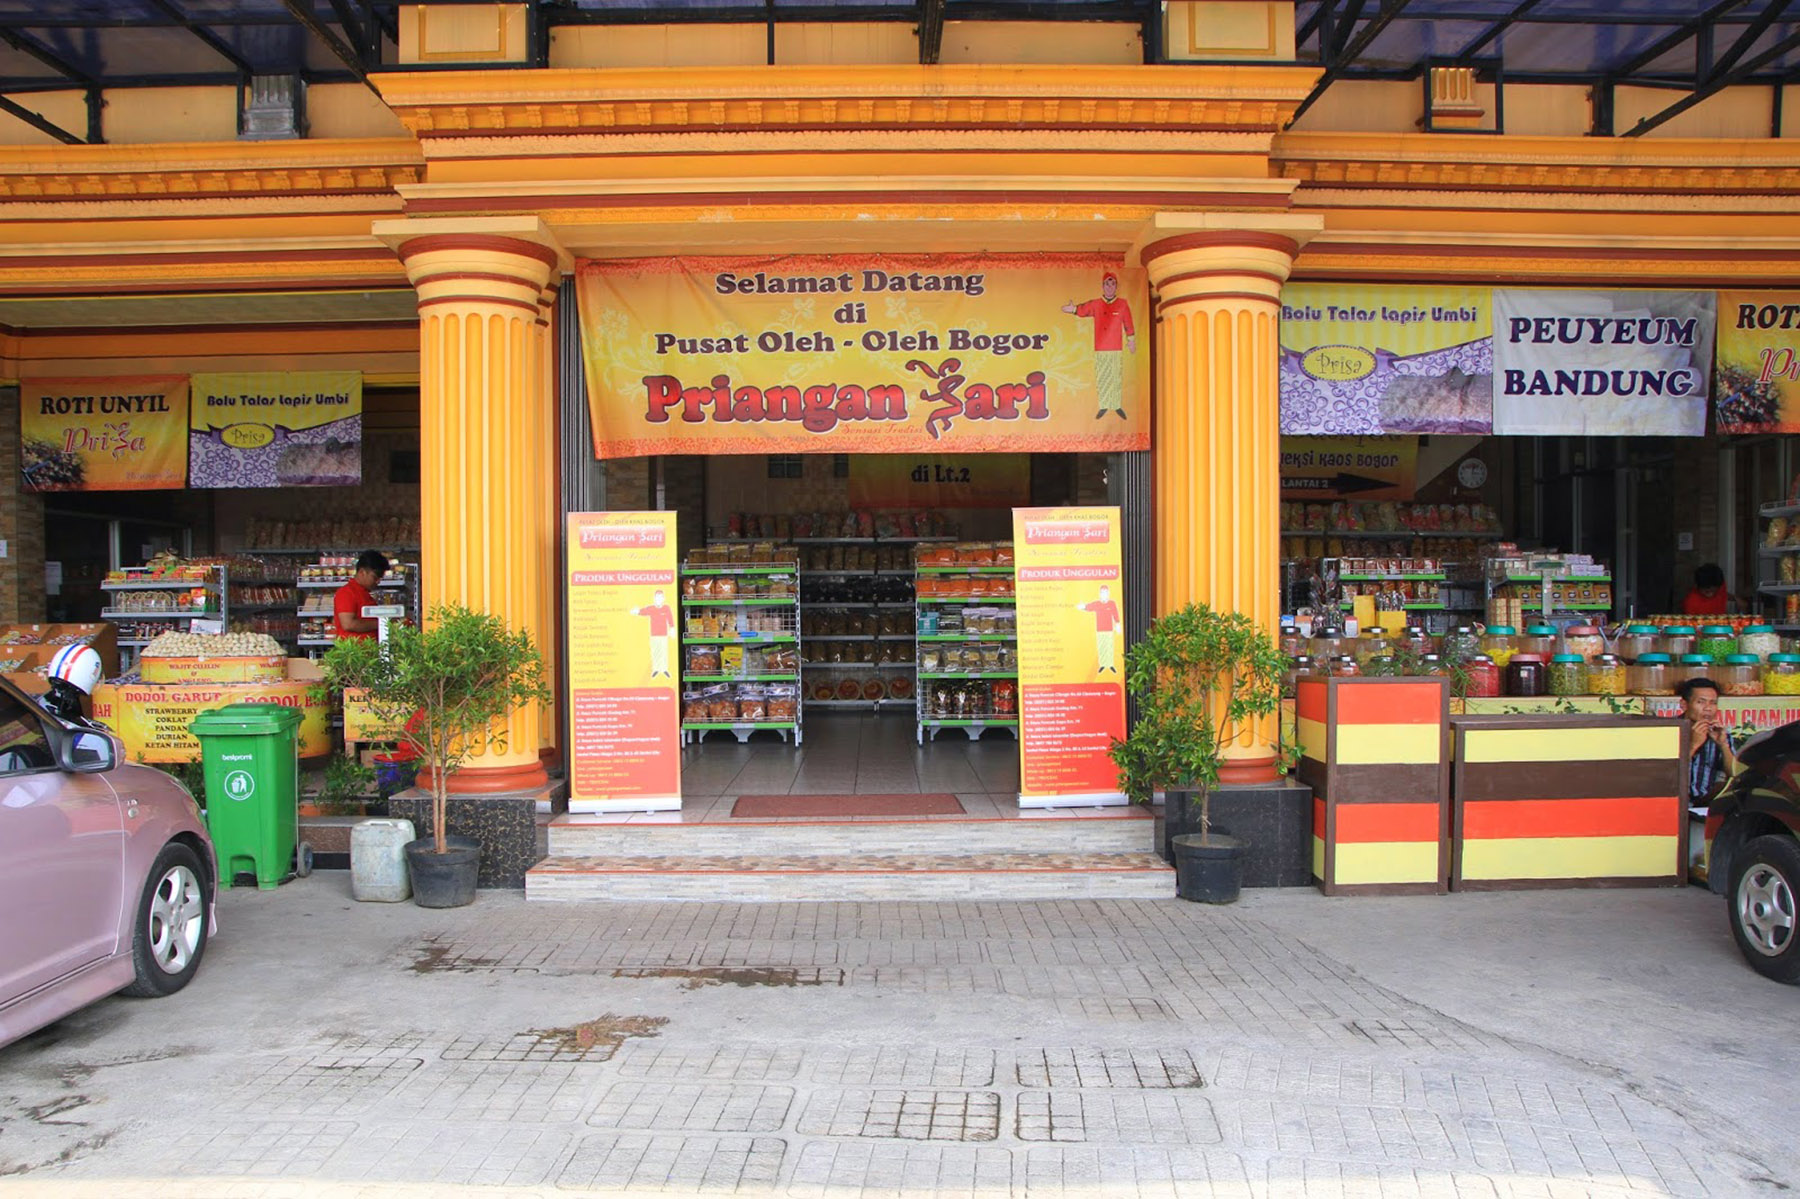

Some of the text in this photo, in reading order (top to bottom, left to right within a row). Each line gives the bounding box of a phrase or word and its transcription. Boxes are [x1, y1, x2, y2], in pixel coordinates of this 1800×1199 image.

[716, 270, 984, 295] Selamat Datang
[834, 303, 867, 323] di
[1281, 305, 1322, 321] Bolu
[1327, 306, 1376, 321] Talas
[1431, 307, 1477, 322] Umbi
[1736, 304, 1800, 329] ROT
[1508, 317, 1697, 344] PEUYEUM
[655, 333, 749, 354] Pusat
[758, 332, 835, 352] Oleh
[862, 330, 939, 351] Oleh
[949, 330, 1049, 355] Bogor
[1316, 353, 1362, 375] Prisa
[1504, 369, 1694, 396] BANDUNG
[40, 395, 170, 415] ROTI UNYIL
[207, 395, 235, 406] Bolu
[240, 395, 275, 406] Talas
[315, 393, 349, 405] Umbi
[642, 358, 1049, 439] Priangan Sari
[911, 465, 970, 482] di Lt.2
[1282, 480, 1329, 488] LANTAI 2
[582, 529, 663, 544] Priangan Sari
[1028, 525, 1107, 541] Priangan Sari
[574, 573, 672, 583] PRODUK UNGGULAN
[1021, 568, 1117, 578] PRODUK UNGGULAN
[125, 692, 222, 702] DODOL GARUT
